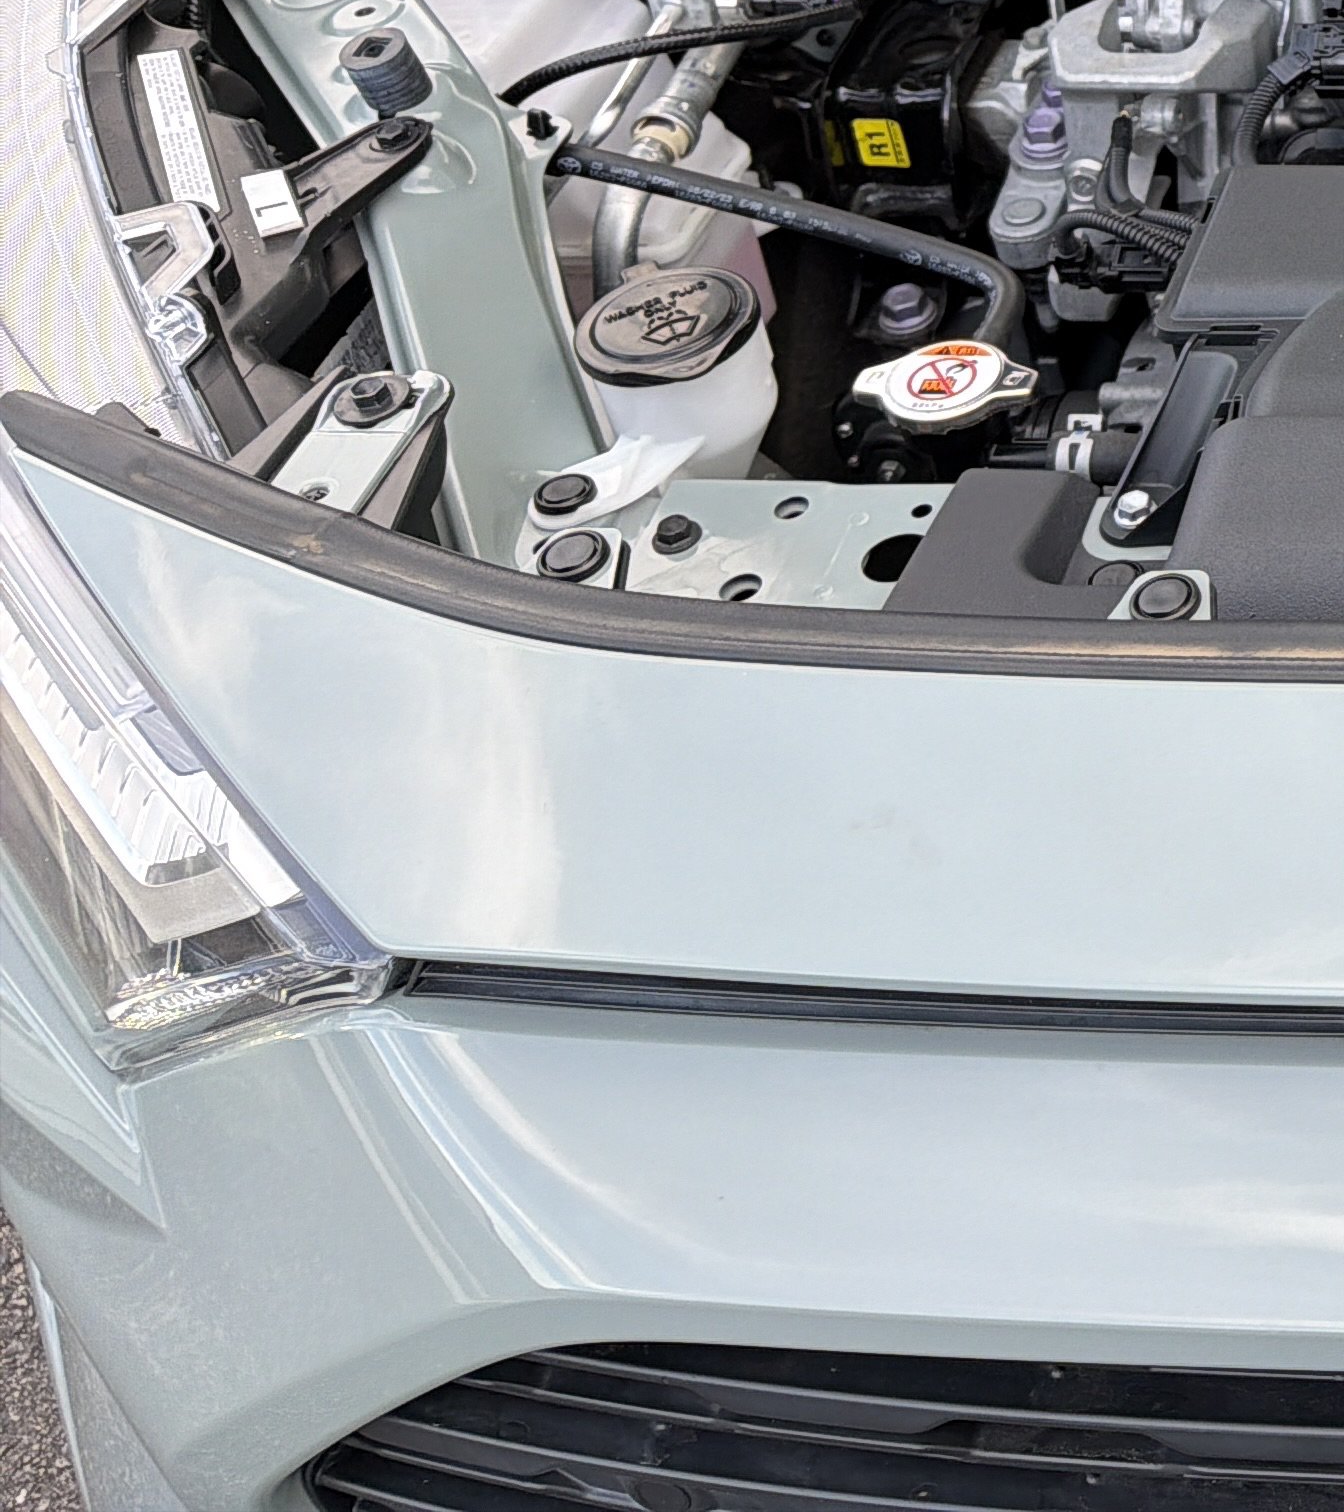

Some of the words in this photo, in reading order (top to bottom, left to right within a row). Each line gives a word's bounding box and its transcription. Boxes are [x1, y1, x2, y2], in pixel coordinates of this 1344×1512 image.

[865, 131, 891, 158] R1
[604, 296, 663, 324] WASHER
[668, 280, 708, 300] FLUID
[643, 299, 678, 319] ONLY
